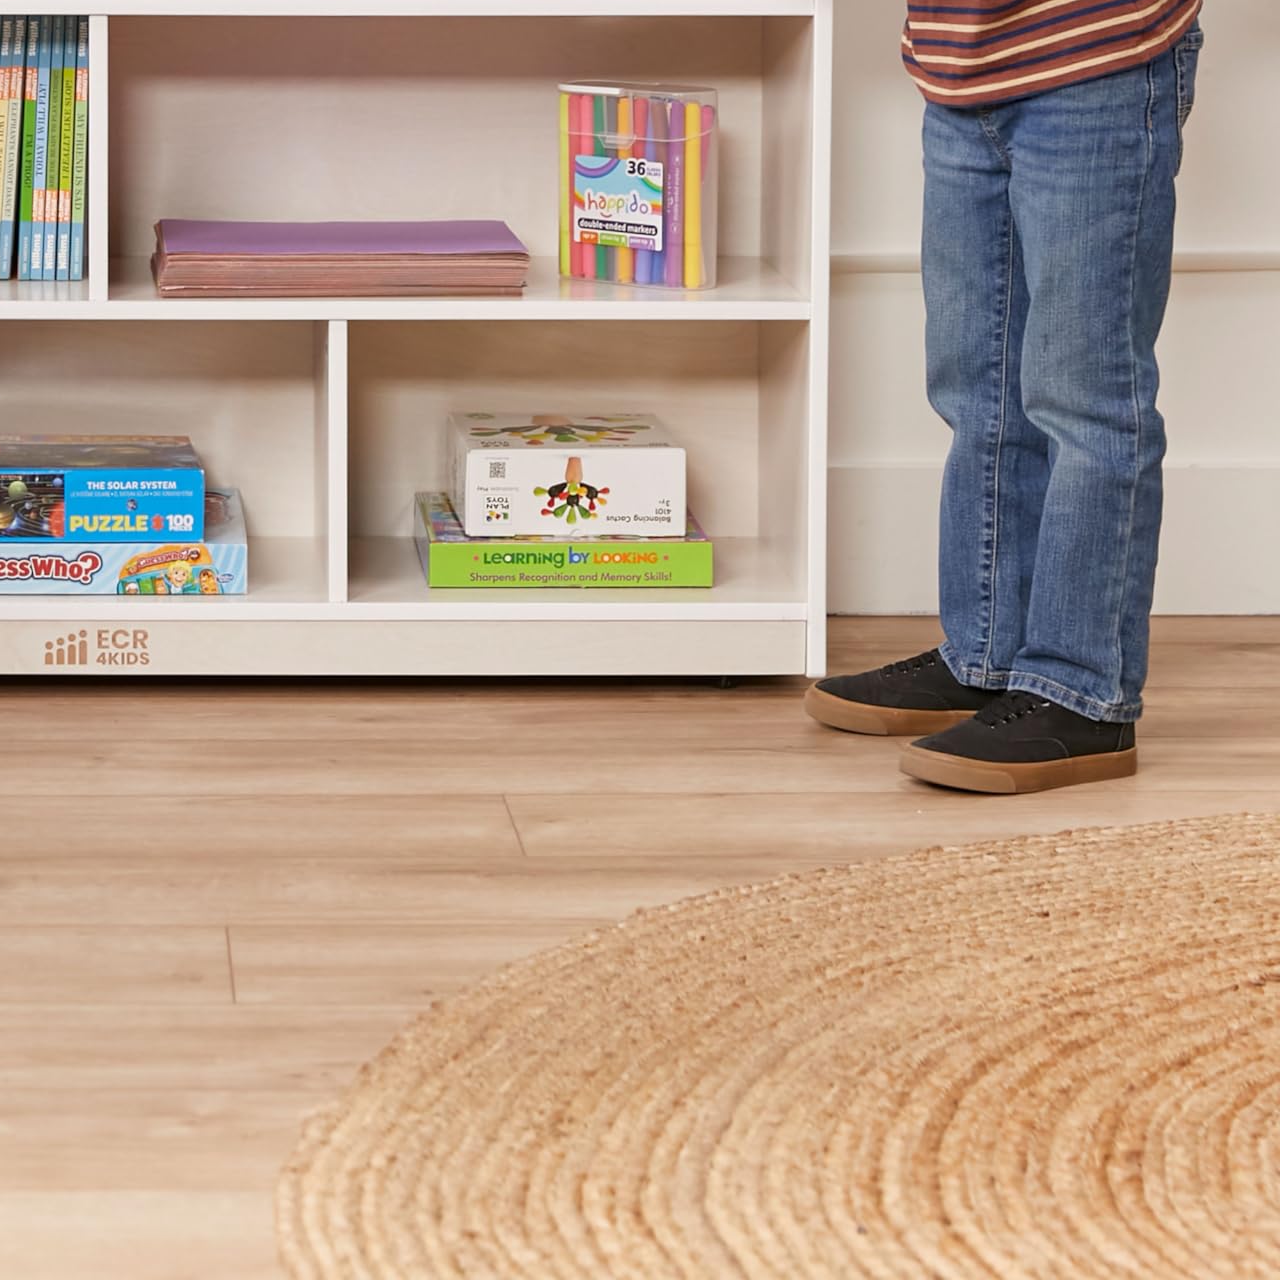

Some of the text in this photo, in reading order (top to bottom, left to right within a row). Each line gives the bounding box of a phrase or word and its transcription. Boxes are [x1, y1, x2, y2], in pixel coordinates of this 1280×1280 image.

[39, 84, 47, 105] FLY!
[37, 106, 46, 135] WILL
[64, 108, 72, 132] LIKE
[25, 134, 33, 148] I'M
[35, 145, 45, 176] TODAY
[62, 134, 71, 173] REALLY
[74, 113, 85, 210] MY FRIEND IS SAD
[23, 160, 32, 189] FROG!
[627, 161, 646, 176] 36
[587, 192, 649, 214] happido
[579, 219, 656, 235] double-ended markers
[87, 481, 176, 490] THE SOLAR SYSTEM
[70, 514, 194, 532] PUZZLE 100
[633, 515, 671, 523] Balancing
[31, 553, 102, 583] Who?
[470, 571, 672, 583] Sharpens Recognition and Memory Skills!
[96, 629, 149, 649] ECR
[96, 652, 150, 665] 4KIDS
